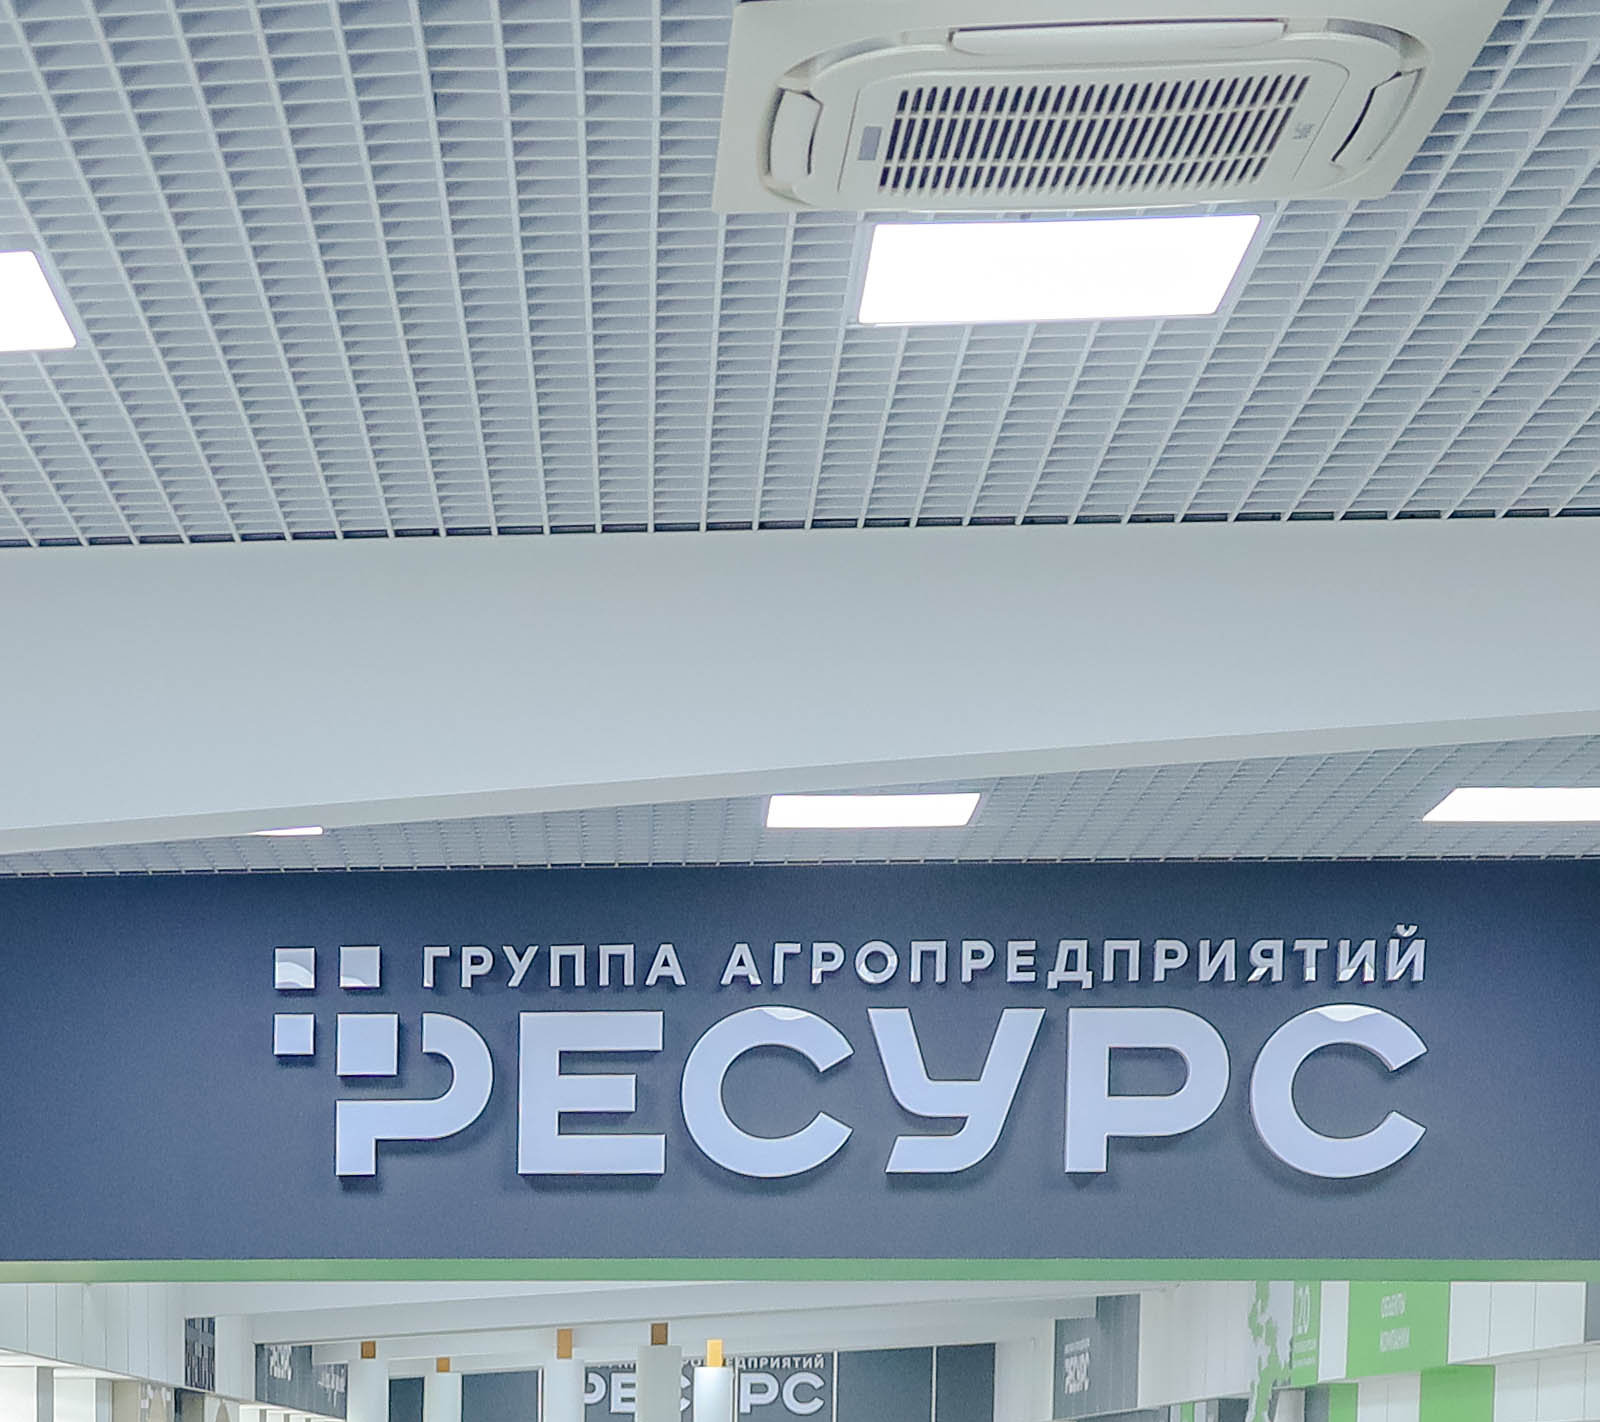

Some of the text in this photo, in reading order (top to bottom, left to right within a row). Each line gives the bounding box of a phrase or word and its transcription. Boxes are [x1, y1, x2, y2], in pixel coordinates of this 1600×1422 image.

[422, 924, 1428, 990] ГРУППА АГРОПРЕДПРИЯТИЙ
[334, 1006, 1428, 1178] РЕСУРС
[584, 1371, 825, 1415] РЕРС
